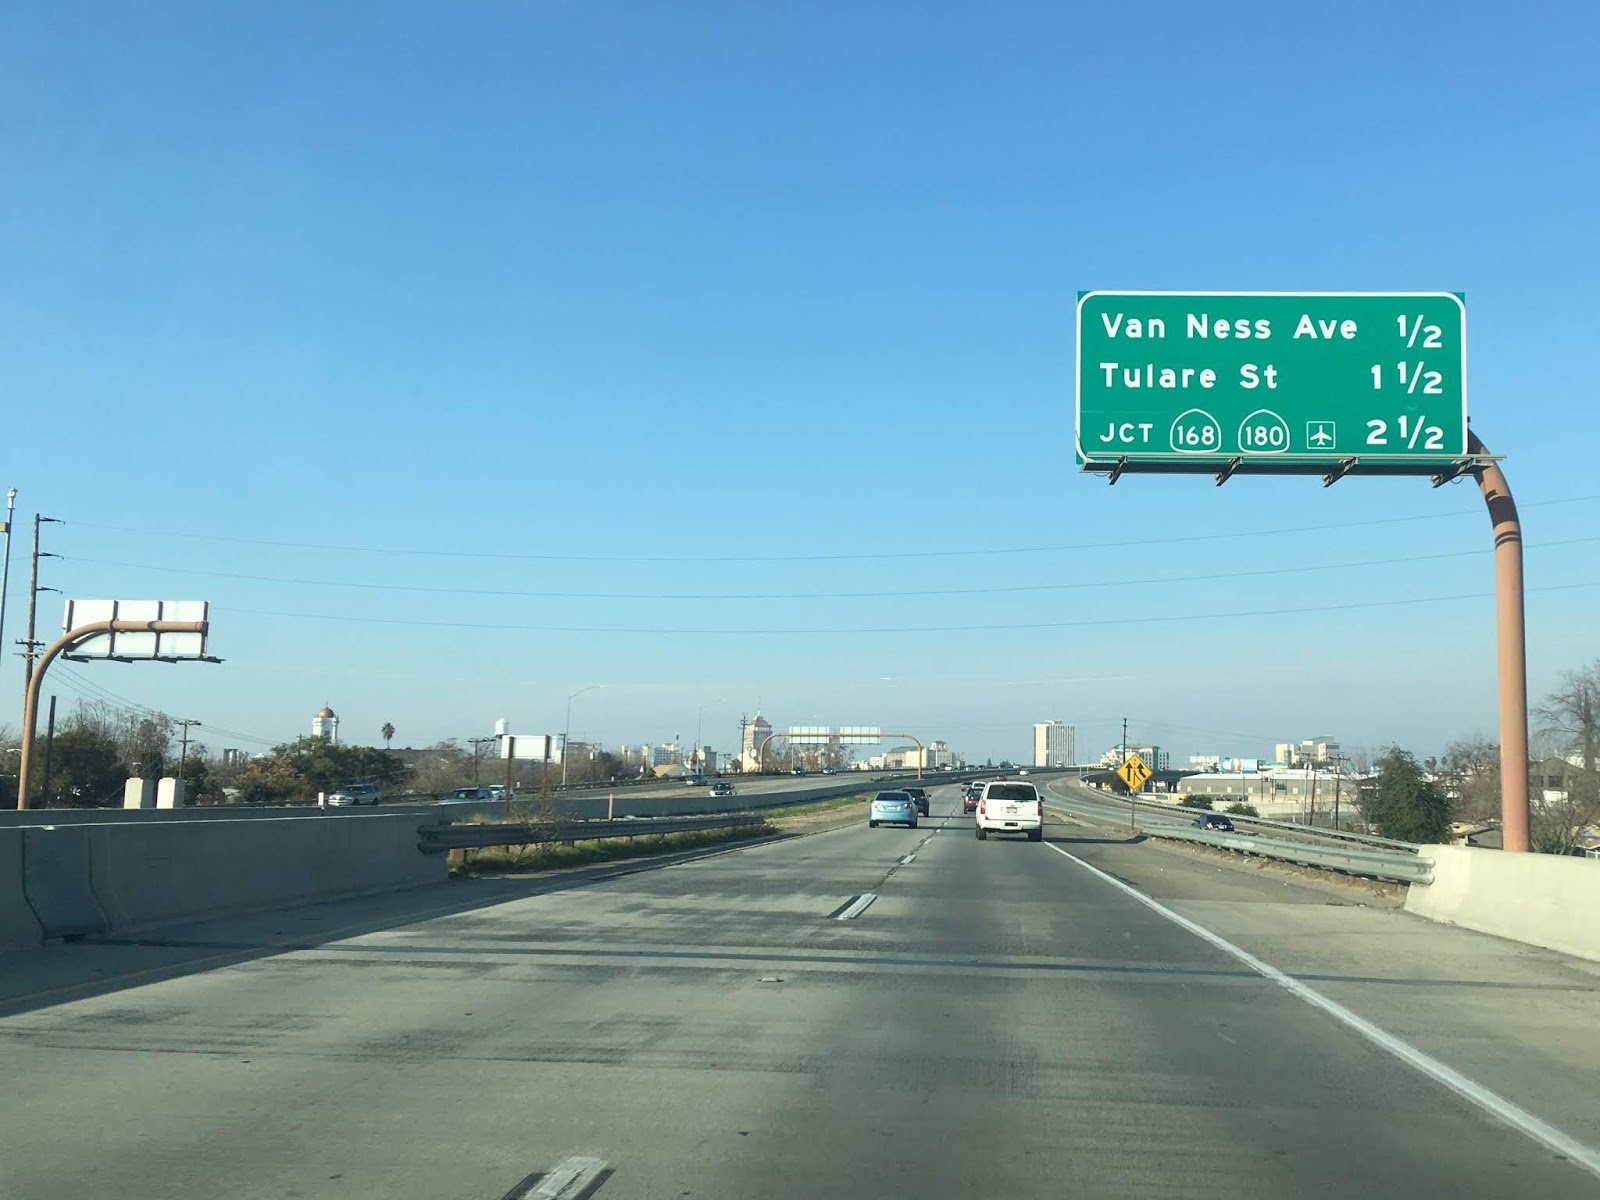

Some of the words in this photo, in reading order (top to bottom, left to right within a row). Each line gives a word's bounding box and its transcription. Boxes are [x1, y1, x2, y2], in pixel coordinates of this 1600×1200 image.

[1101, 313, 1165, 339] Van
[1186, 313, 1272, 340] Ness
[1293, 313, 1358, 340] Ave
[1100, 362, 1217, 389] Tulare
[1239, 363, 1278, 389] St
[1100, 422, 1153, 443] JCT
[1177, 425, 1215, 446] 168
[1245, 425, 1284, 446] 180
